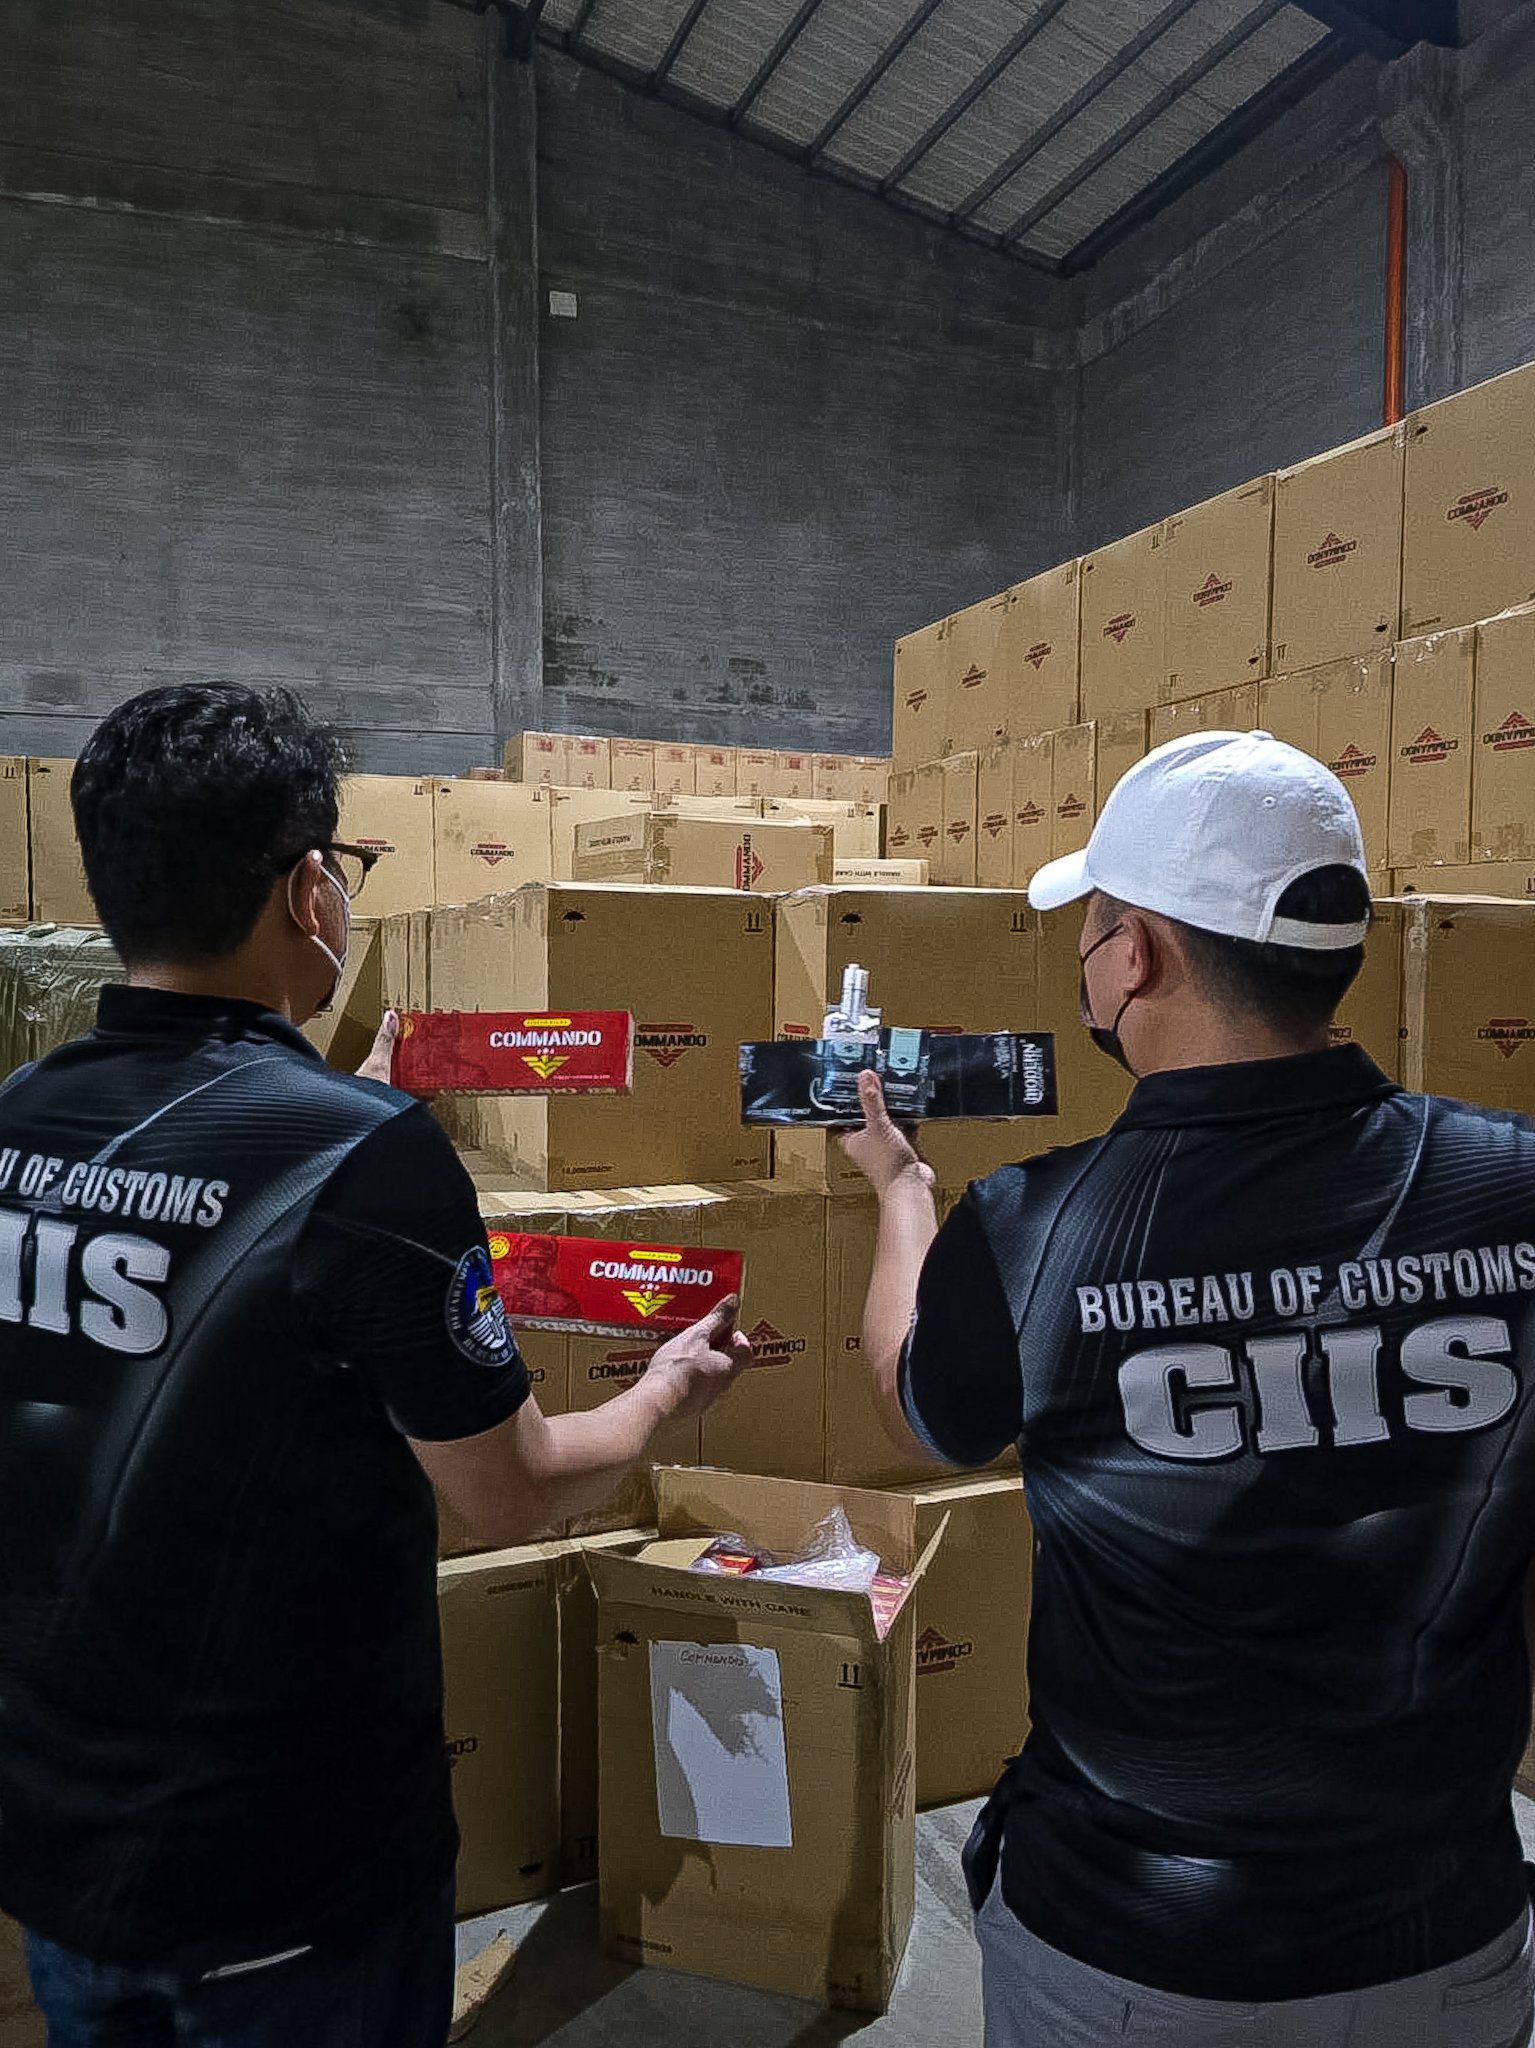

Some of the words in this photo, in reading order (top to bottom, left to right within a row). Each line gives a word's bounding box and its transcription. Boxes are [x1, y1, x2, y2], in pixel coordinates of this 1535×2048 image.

[743, 834, 751, 891] OMMANDO
[489, 1030, 602, 1048] COMMANDO
[634, 1034, 707, 1048] OMMANDO
[18, 1154, 64, 1198] OF
[62, 1162, 230, 1228] CUSTOMS
[0, 1208, 171, 1354] IIS
[589, 1260, 713, 1287] COMMANDO
[1076, 1272, 1255, 1334] BUREAU
[1270, 1265, 1323, 1316] OF
[1338, 1242, 1535, 1310] CUSTOMS
[752, 1338, 806, 1355] COMMA
[588, 1359, 651, 1381] COMMA
[1118, 1315, 1518, 1460] CIIS
